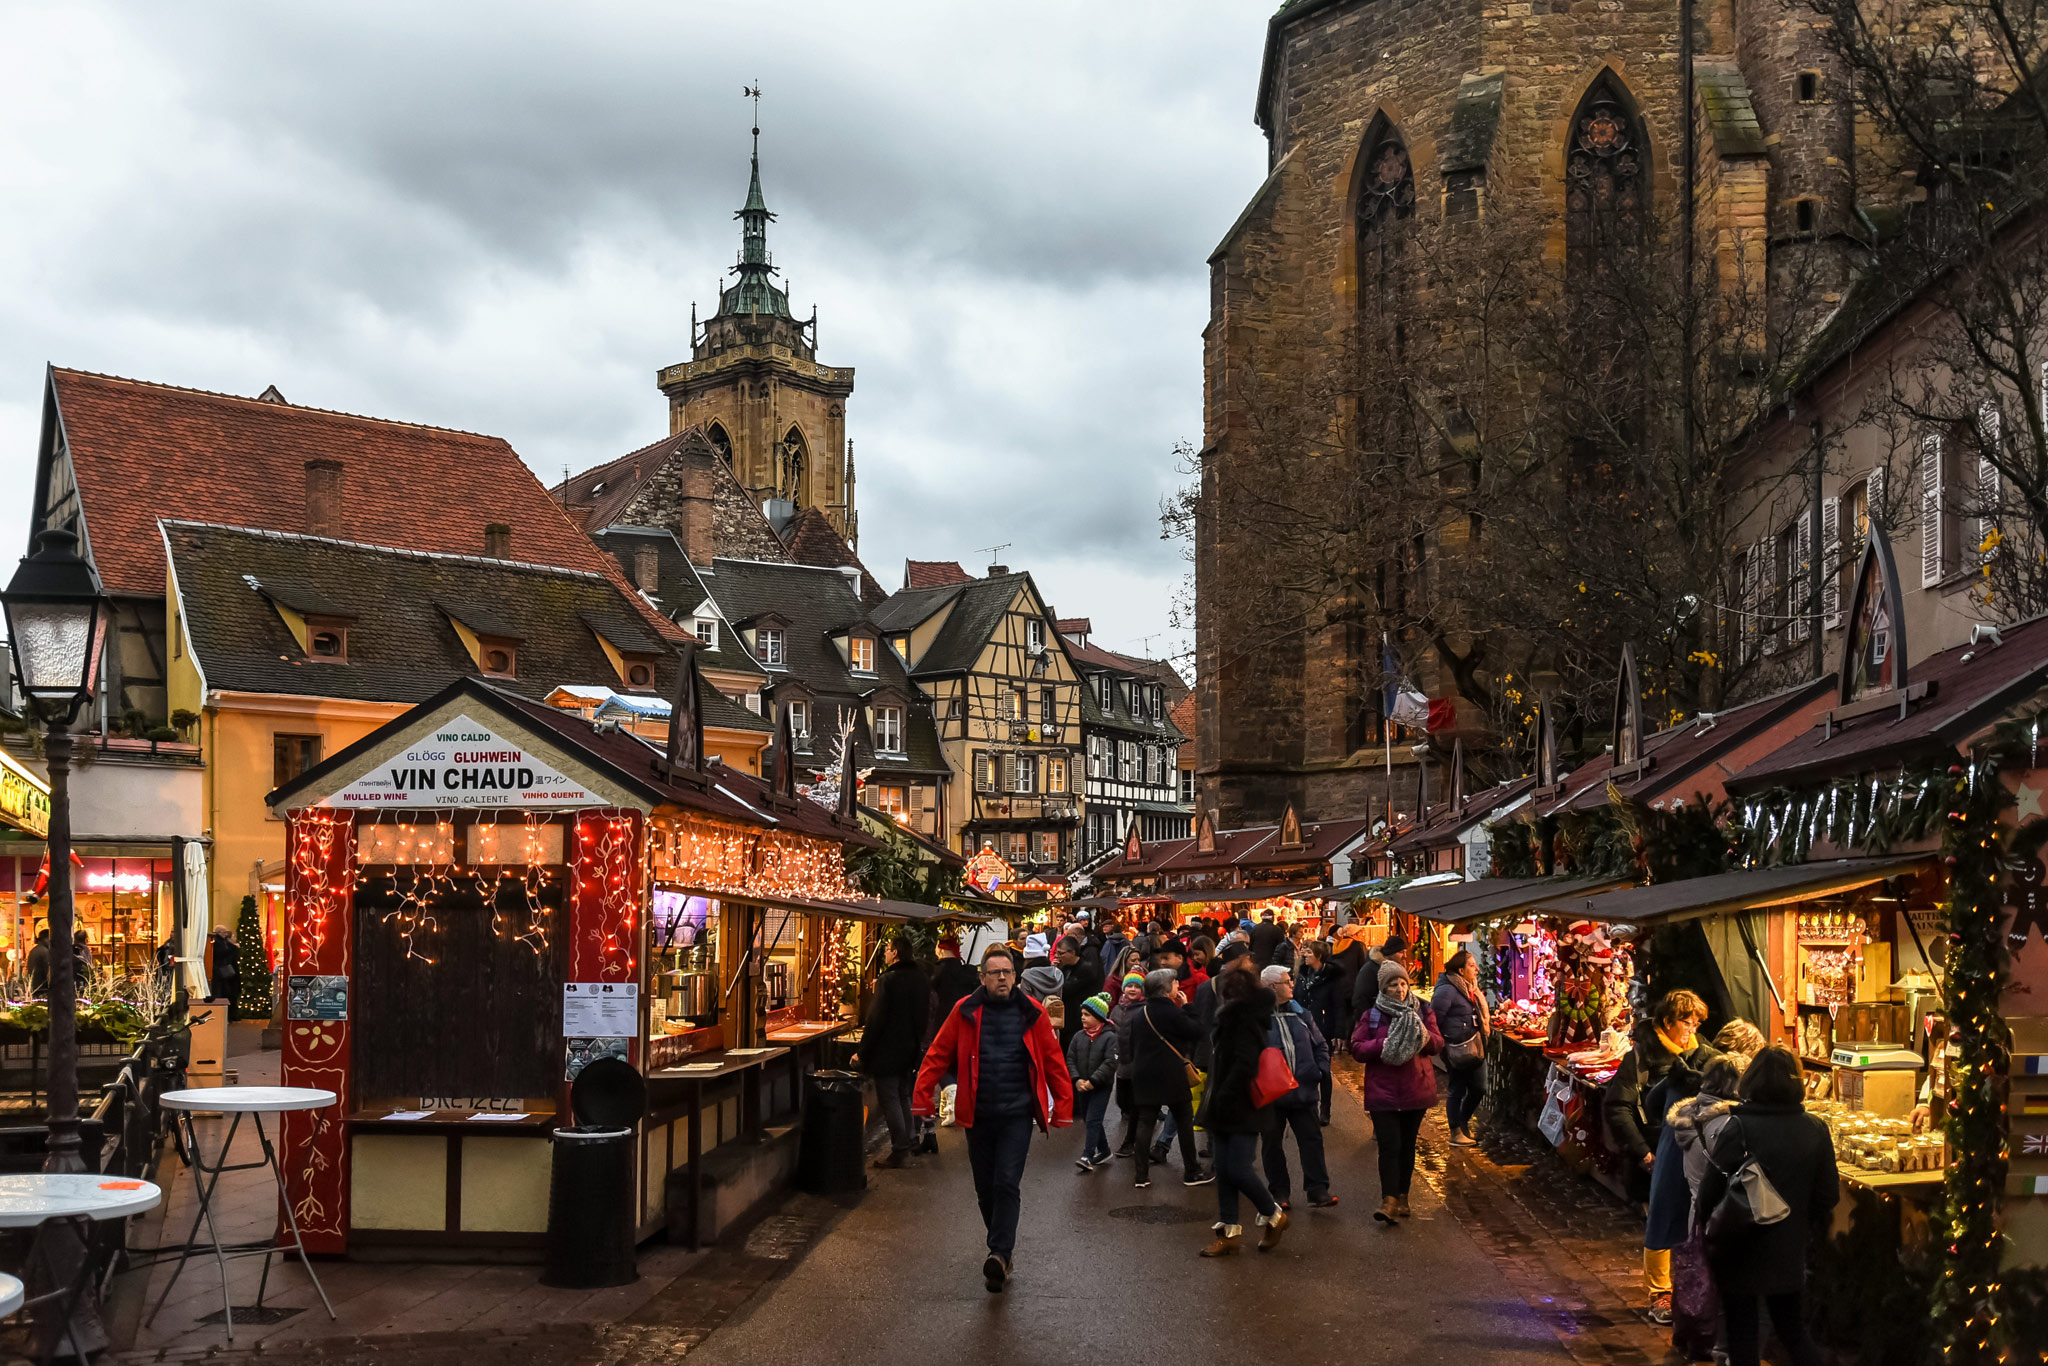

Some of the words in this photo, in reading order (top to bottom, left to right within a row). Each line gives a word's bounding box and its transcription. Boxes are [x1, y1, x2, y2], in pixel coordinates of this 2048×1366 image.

[437, 733, 459, 742] VINO
[461, 733, 491, 742] CALDO
[407, 750, 446, 761] GLÖGG
[454, 751, 522, 763] GLUHWEIN
[391, 768, 436, 790] VIN
[443, 768, 534, 790] CHAUD
[343, 793, 381, 801] MULLED
[383, 793, 408, 801] WINE
[463, 795, 509, 803] CALIENTE
[551, 791, 585, 799] QUENTE
